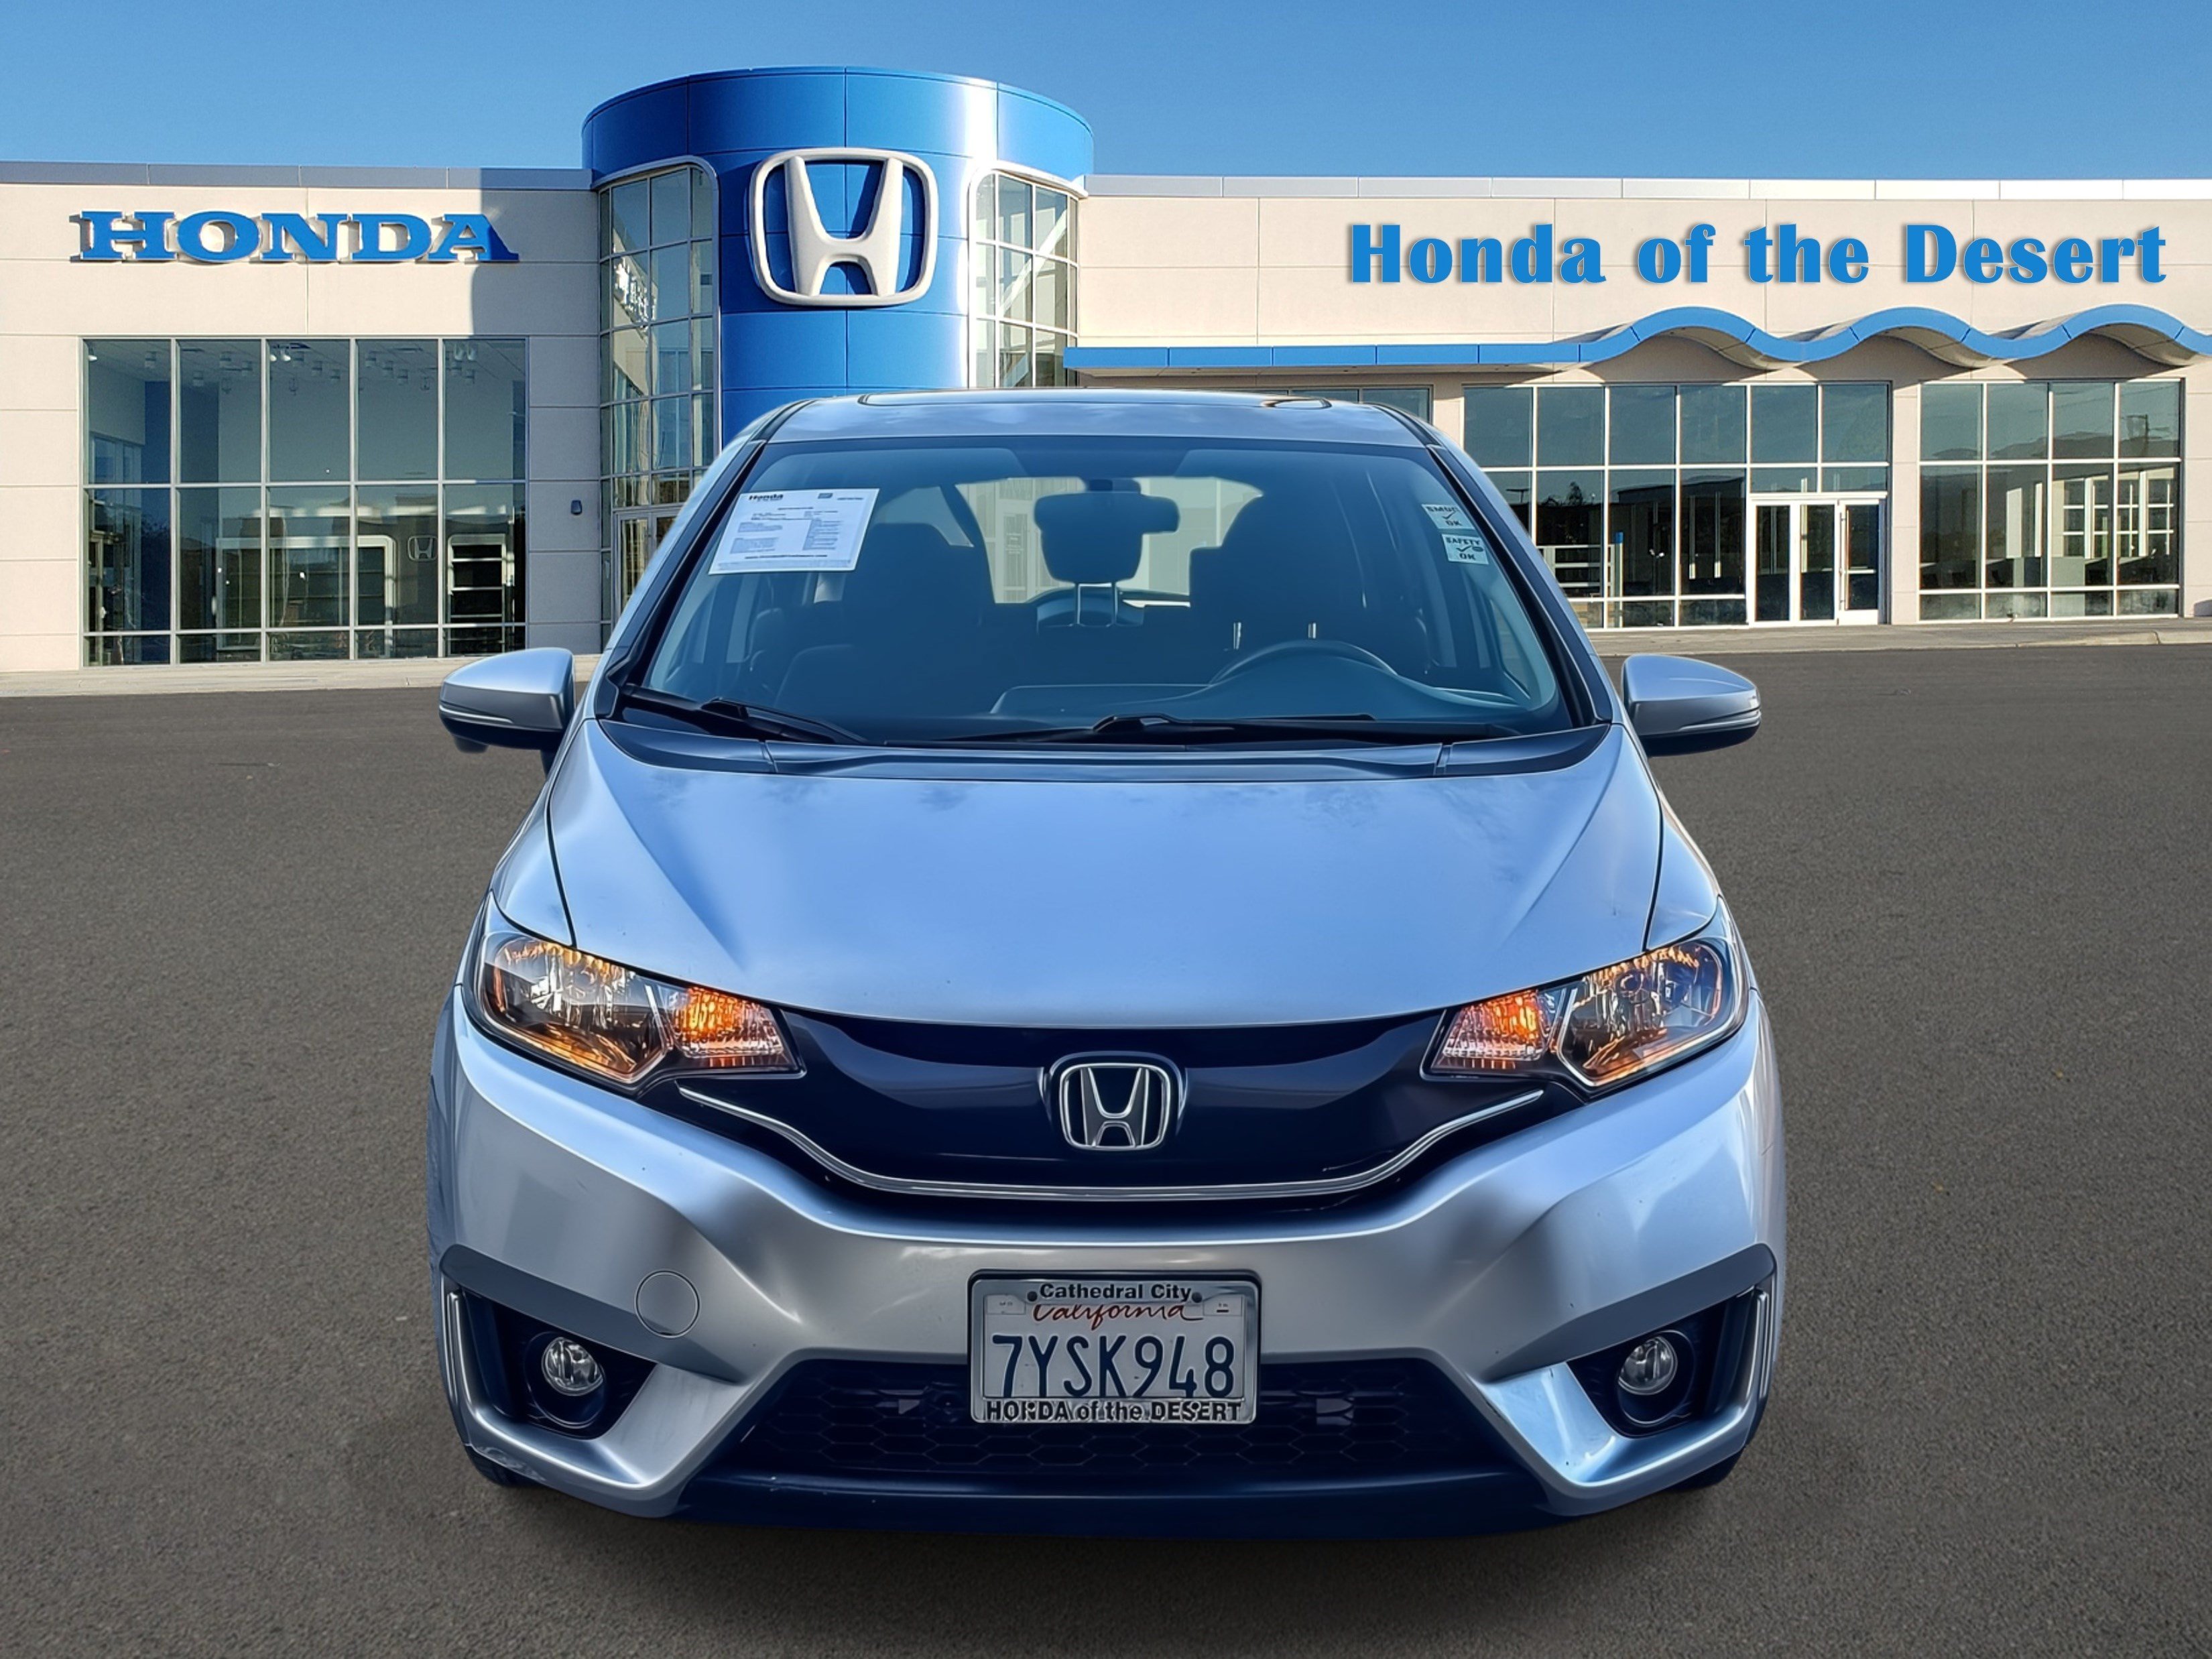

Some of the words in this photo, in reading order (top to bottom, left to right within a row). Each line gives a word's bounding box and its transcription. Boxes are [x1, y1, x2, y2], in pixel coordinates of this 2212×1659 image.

[78, 210, 519, 262] HONDA
[1351, 223, 1607, 284] Honda
[1638, 223, 1717, 284] of
[1743, 223, 1869, 284] the
[1906, 225, 2167, 284] Desert
[1040, 1284, 1142, 1299] Cathedral
[1151, 1284, 1192, 1302] City
[1033, 1304, 1204, 1331] California
[993, 1335, 1235, 1398] 7YSK948
[987, 1400, 1069, 1420] HONDA
[1077, 1400, 1099, 1420] of
[1106, 1401, 1142, 1420] the
[1151, 1402, 1242, 1421] DESERT
